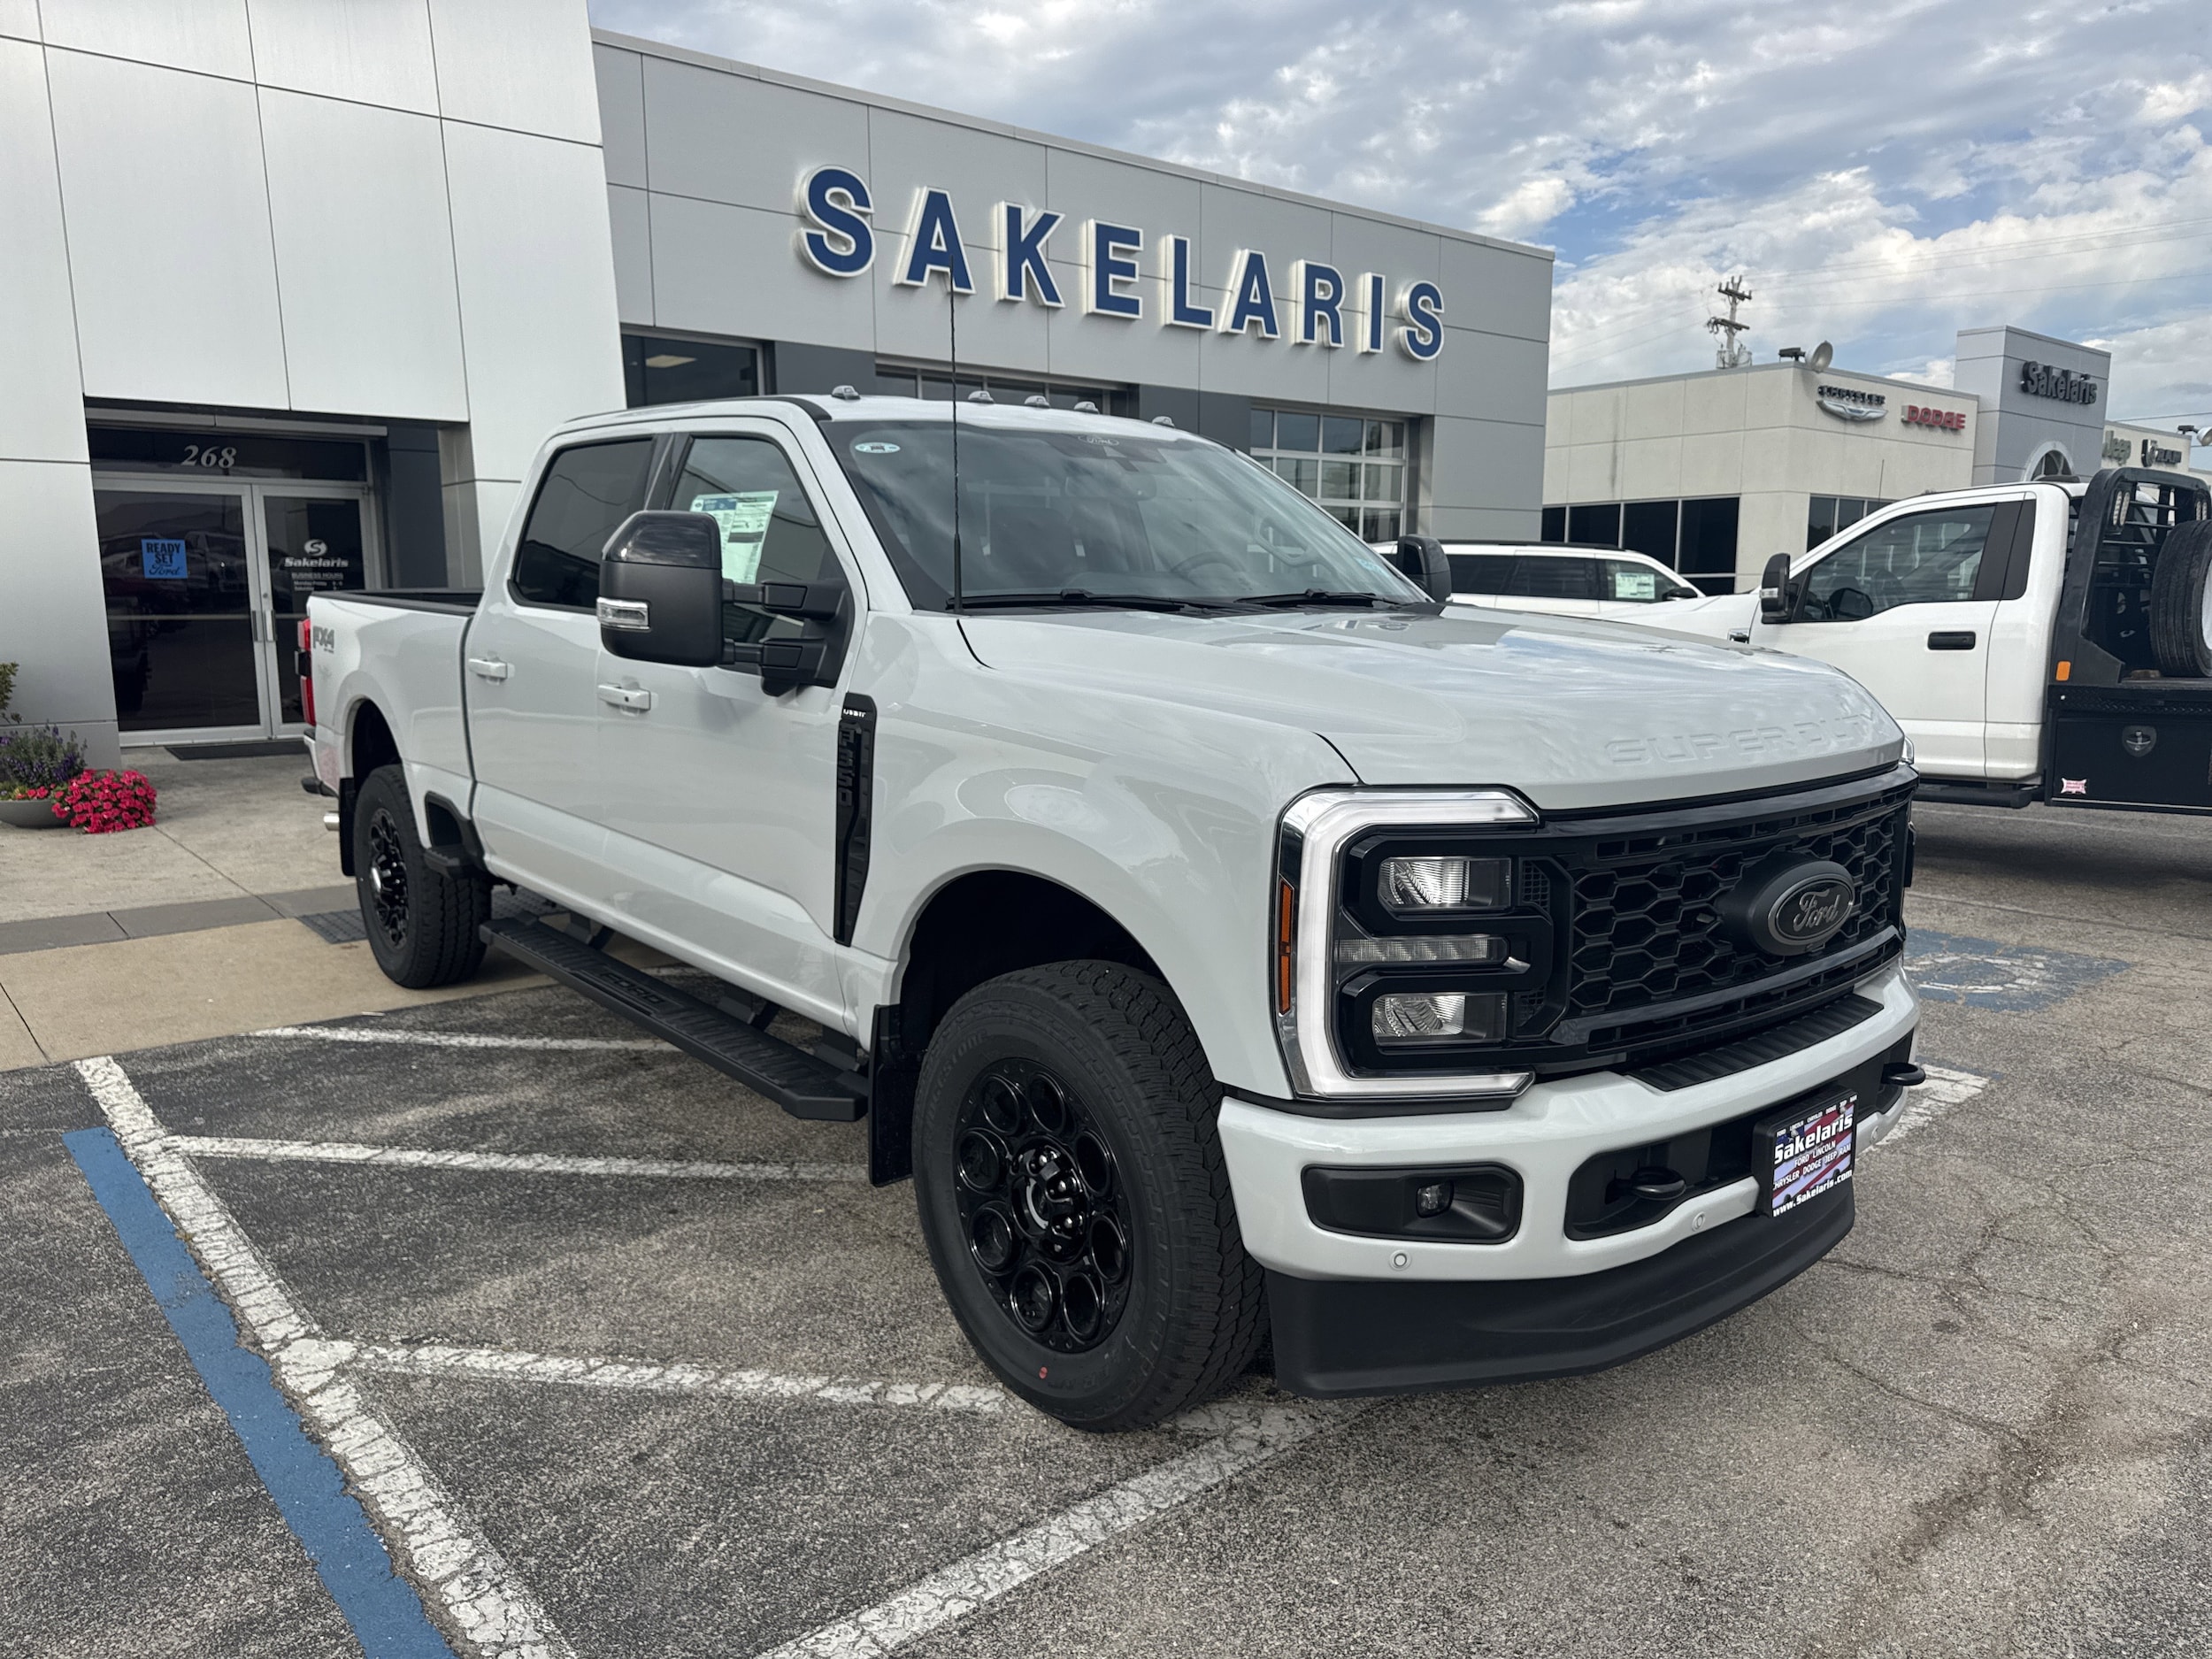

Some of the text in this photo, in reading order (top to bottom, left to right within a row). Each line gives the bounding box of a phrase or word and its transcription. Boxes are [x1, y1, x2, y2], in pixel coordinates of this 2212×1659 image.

[798, 165, 1444, 360] SAKELARIS
[2023, 360, 2097, 404] Sakelaris
[1905, 404, 1966, 430] DODGE
[180, 444, 237, 468] 268
[2155, 449, 2182, 464] RAM
[146, 541, 180, 554] READY
[155, 552, 173, 565] SET
[149, 563, 181, 575] Ford
[284, 557, 349, 567] Sakelaris
[312, 626, 334, 649] FX4
[1793, 888, 1840, 932] Ford
[1774, 1114, 1853, 1164] Sakelaris
[1794, 1141, 1836, 1168] FORD LINCOLN
[1802, 1159, 1822, 1175] DODGE
[1824, 1150, 1838, 1164] JEEP
[1839, 1143, 1852, 1156] RAM
[1773, 1170, 1853, 1217] www.Sakelaris.com
